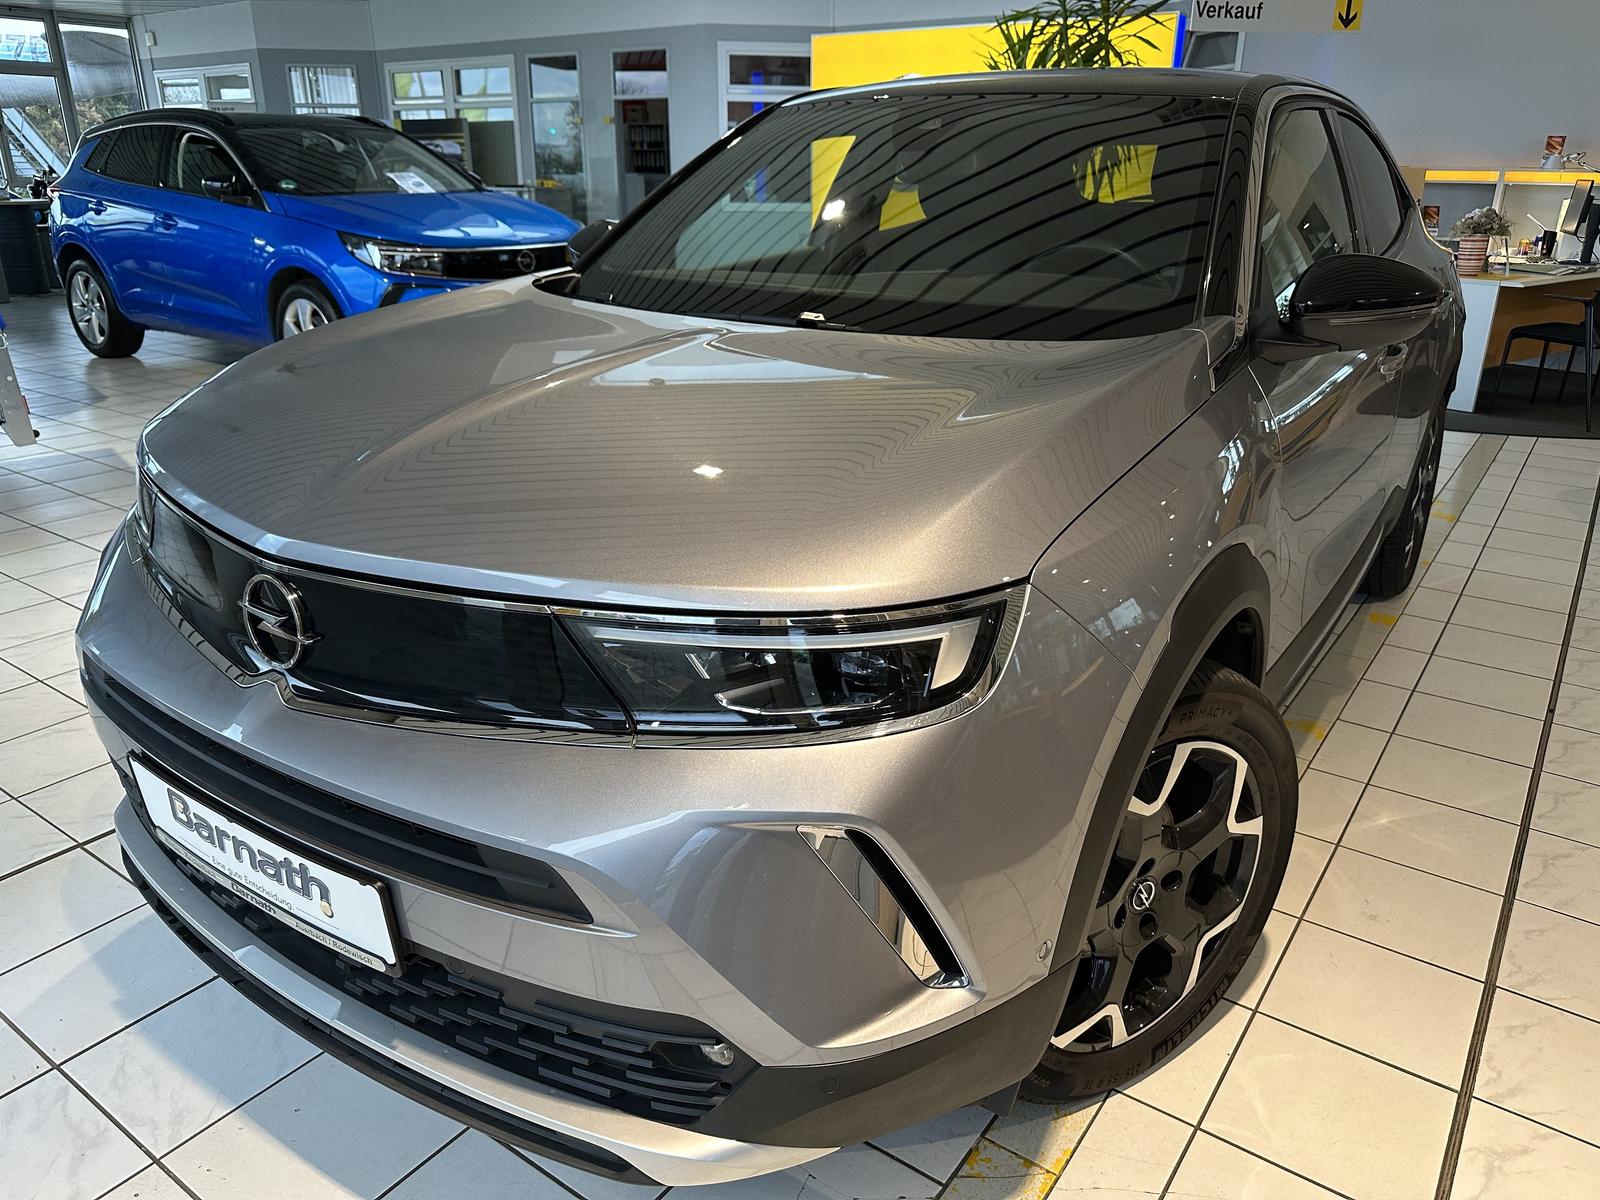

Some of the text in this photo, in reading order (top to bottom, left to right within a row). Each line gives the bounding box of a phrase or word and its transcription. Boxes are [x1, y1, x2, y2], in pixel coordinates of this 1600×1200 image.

[1196, 1, 1263, 19] Verkauf
[1180, 707, 1226, 723] PRIMACY
[167, 787, 334, 918] Barnath
[212, 855, 228, 873] Eine
[227, 864, 244, 882] gute
[295, 921, 328, 945] Auerbach
[332, 941, 374, 966] Rodewisch
[1156, 978, 1231, 1061] MICHELIN
